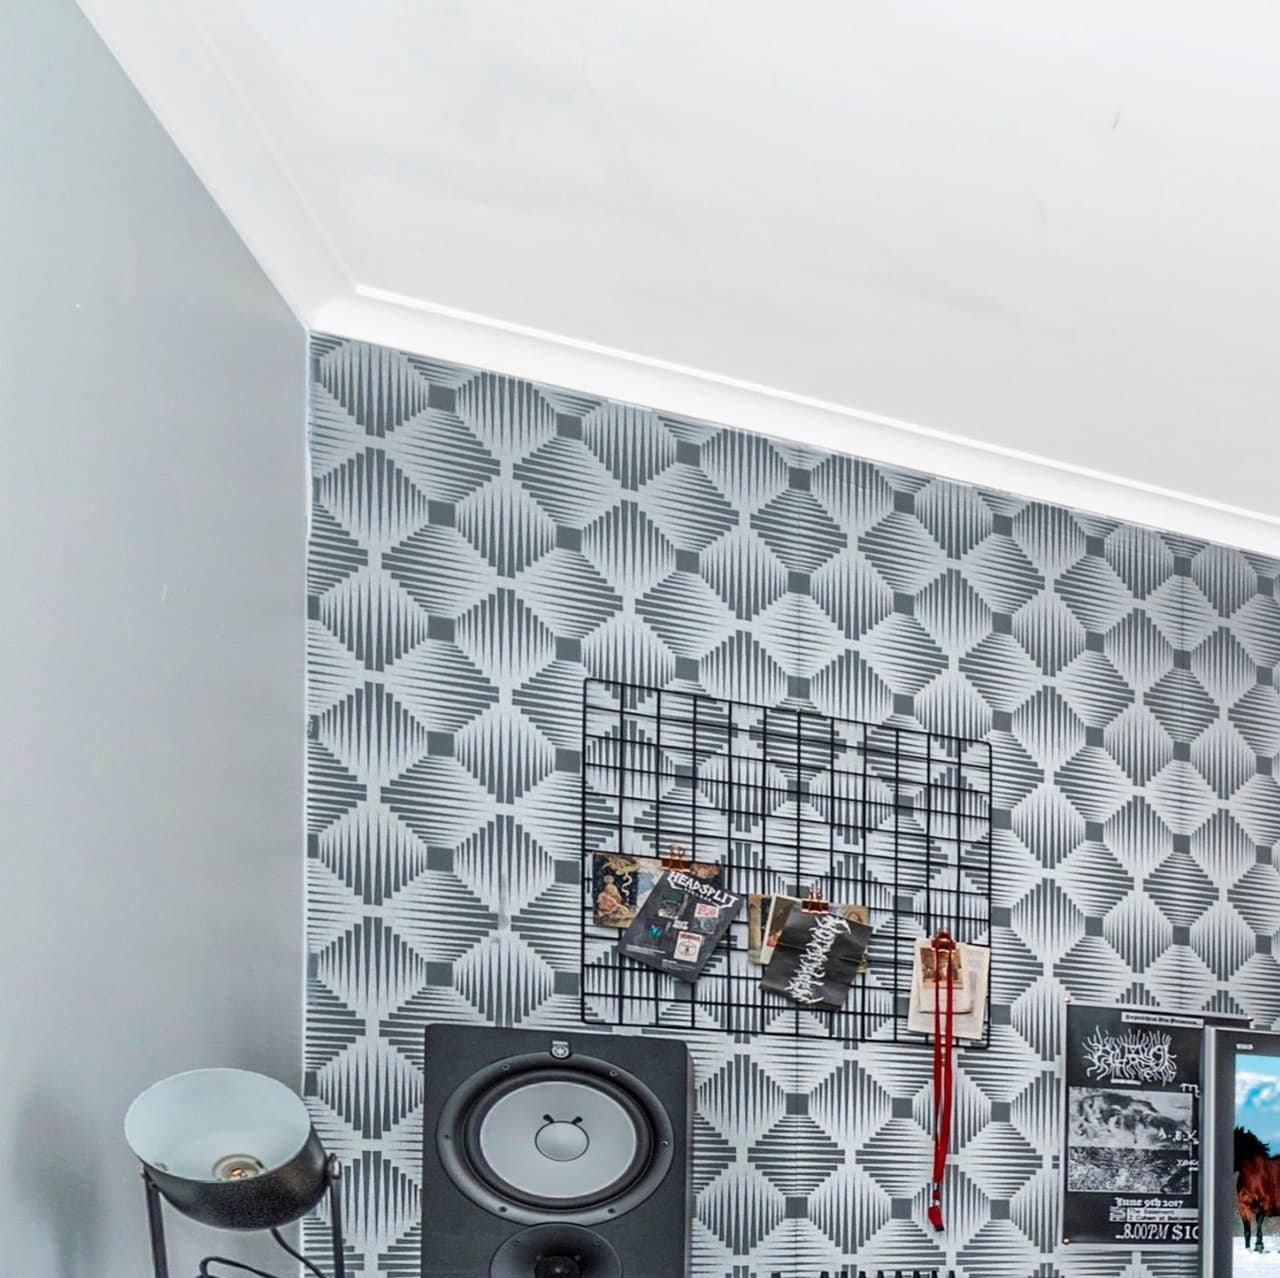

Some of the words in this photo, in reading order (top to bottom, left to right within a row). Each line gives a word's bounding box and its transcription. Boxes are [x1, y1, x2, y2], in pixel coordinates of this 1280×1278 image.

[667, 870, 739, 909] HEADSPLIT
[1114, 1197, 1143, 1207] June
[1162, 1199, 1184, 1209] 2017
